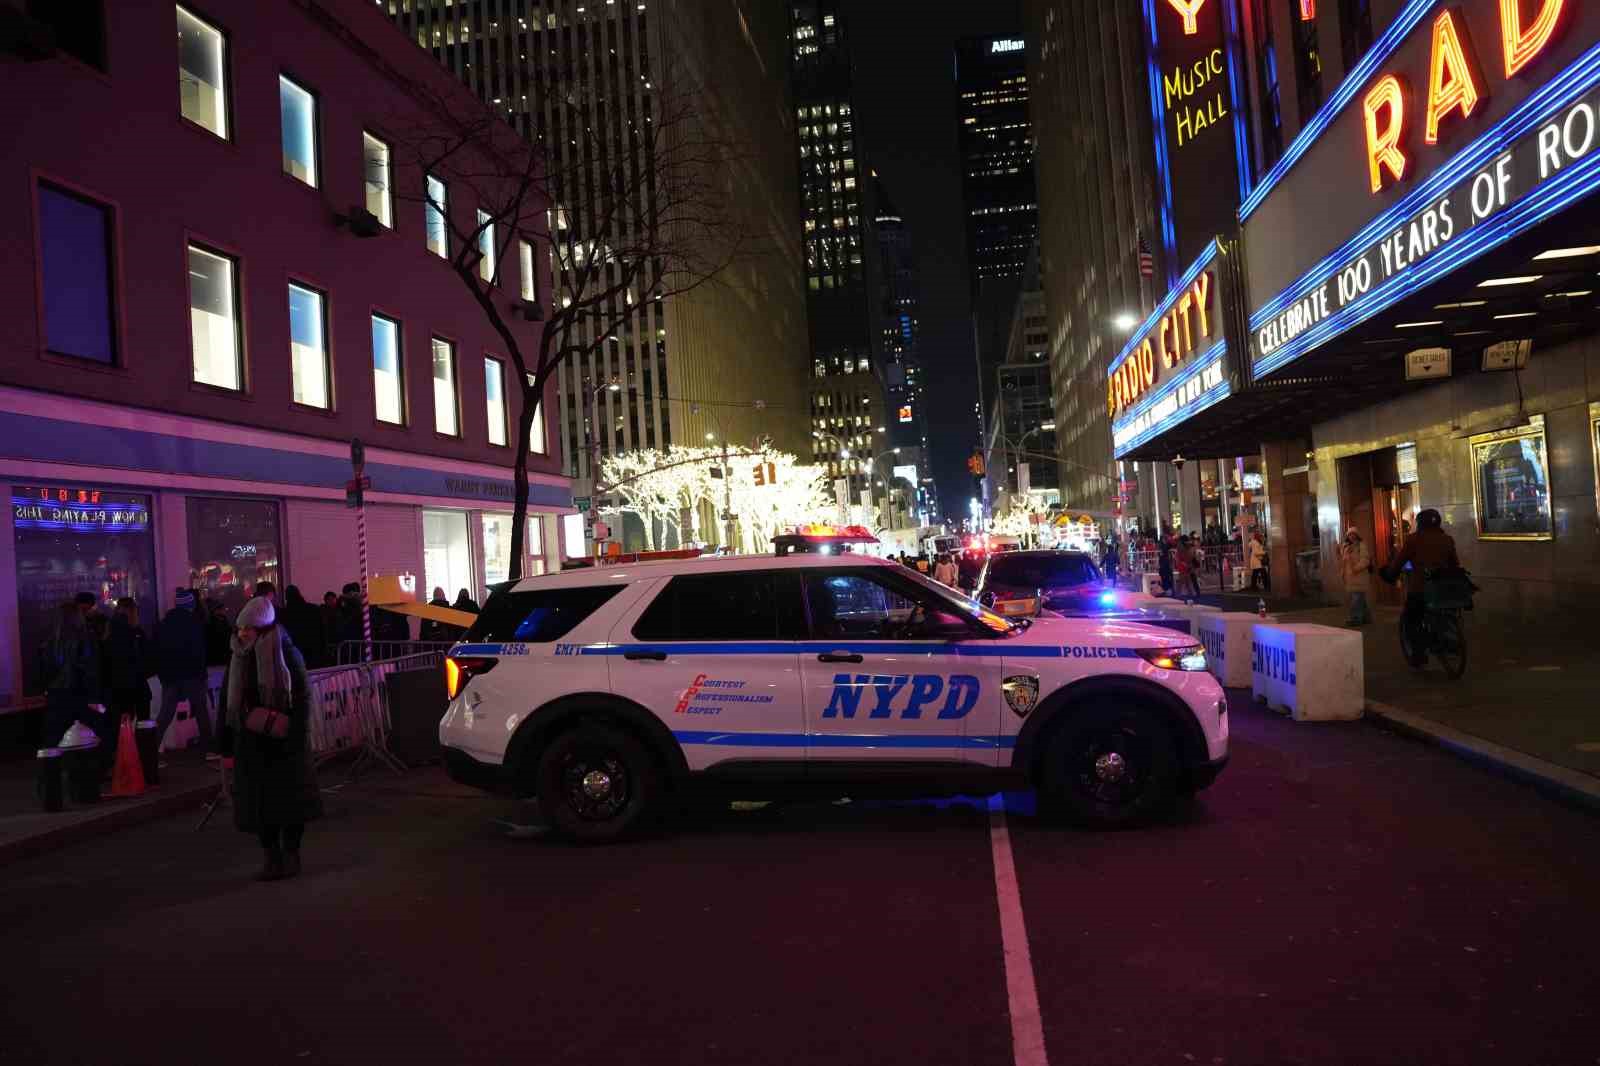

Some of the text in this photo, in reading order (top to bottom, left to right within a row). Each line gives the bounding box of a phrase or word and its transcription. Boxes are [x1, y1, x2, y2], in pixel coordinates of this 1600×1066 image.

[1163, 48, 1223, 110] MUSIC
[1175, 93, 1228, 147] HALL
[1258, 286, 1330, 355] CELEBRATE
[1338, 258, 1371, 306] 100
[1381, 199, 1453, 276] YEARS
[1471, 154, 1513, 219] OF
[1113, 338, 1154, 414] RADIO
[1160, 271, 1208, 369] CITY
[1062, 646, 1118, 658] POLICE
[1257, 640, 1289, 682] NYPD
[822, 674, 981, 720] NYPD
